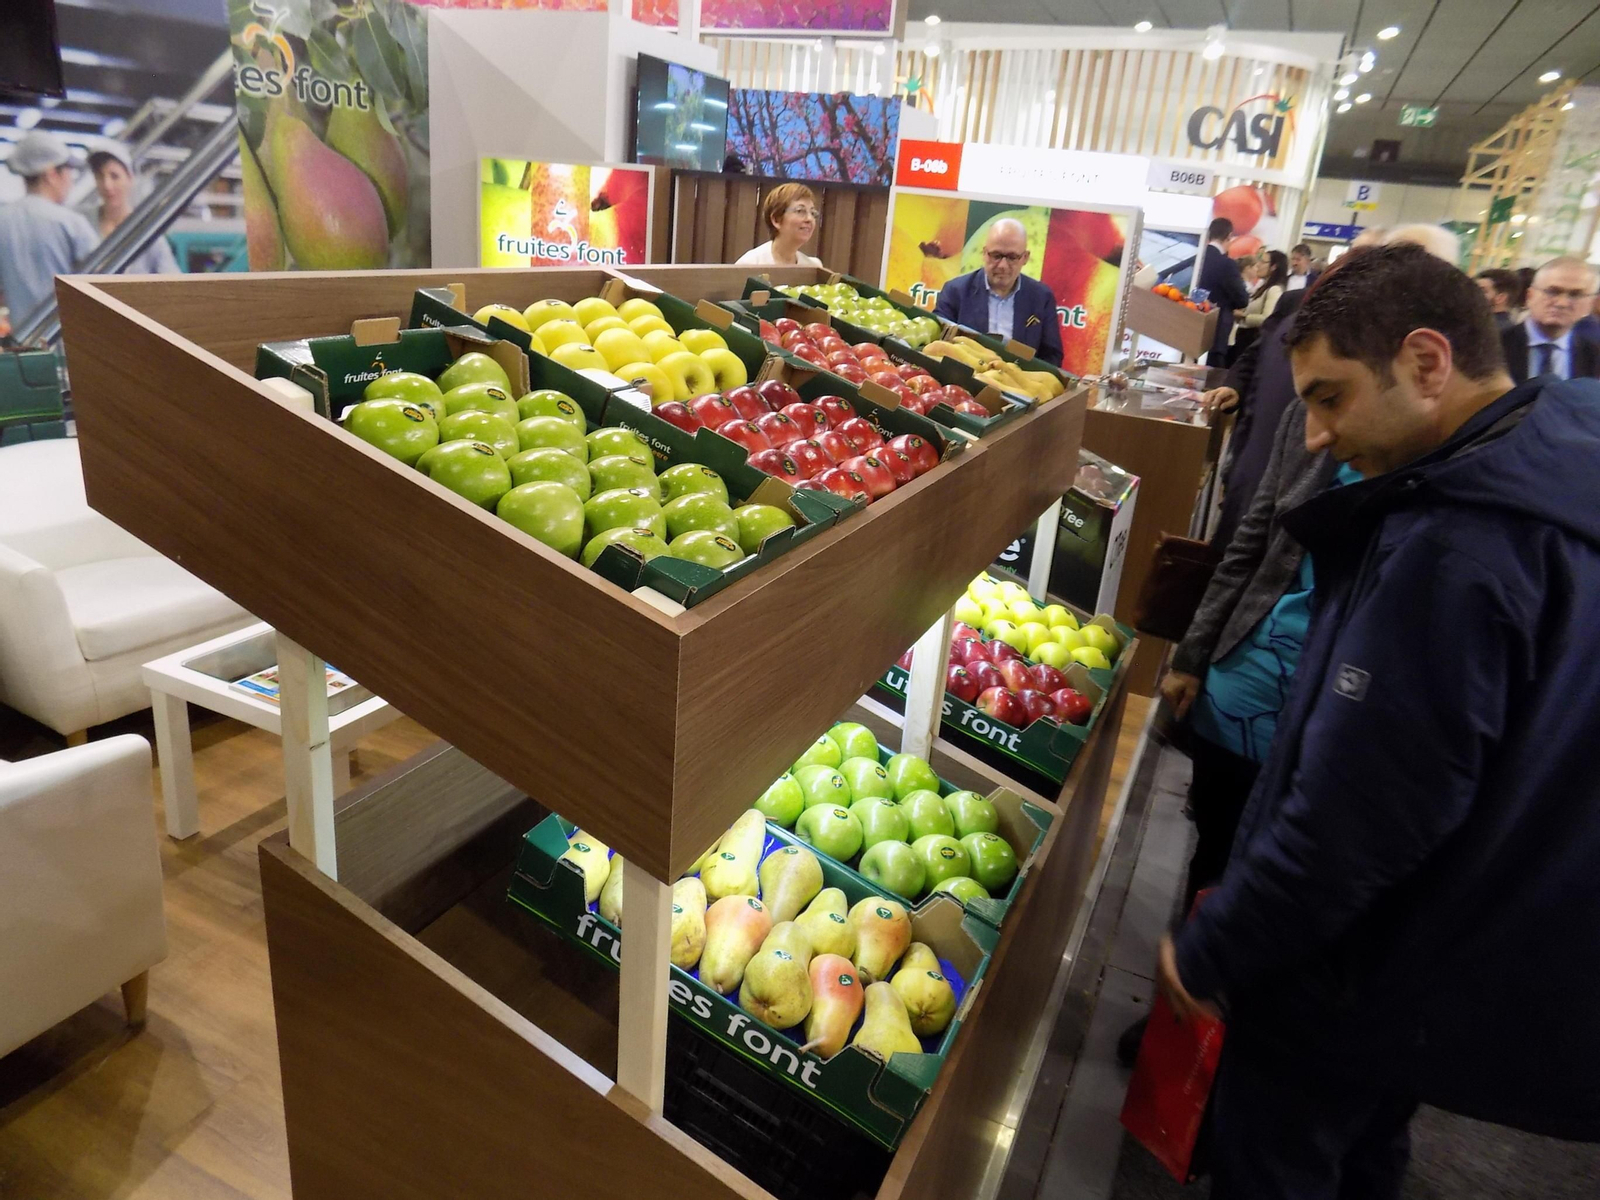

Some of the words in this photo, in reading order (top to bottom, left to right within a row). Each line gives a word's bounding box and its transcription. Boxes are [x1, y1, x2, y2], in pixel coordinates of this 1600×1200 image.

[294, 67, 368, 109] font
[1170, 170, 1206, 185] B06B
[498, 234, 569, 259] fruites
[577, 243, 625, 264] font
[910, 283, 941, 305] fr
[1136, 349, 1162, 359] year
[344, 371, 380, 384] fruites
[651, 438, 672, 454] font
[961, 709, 1022, 752] font
[726, 1013, 822, 1089] font
